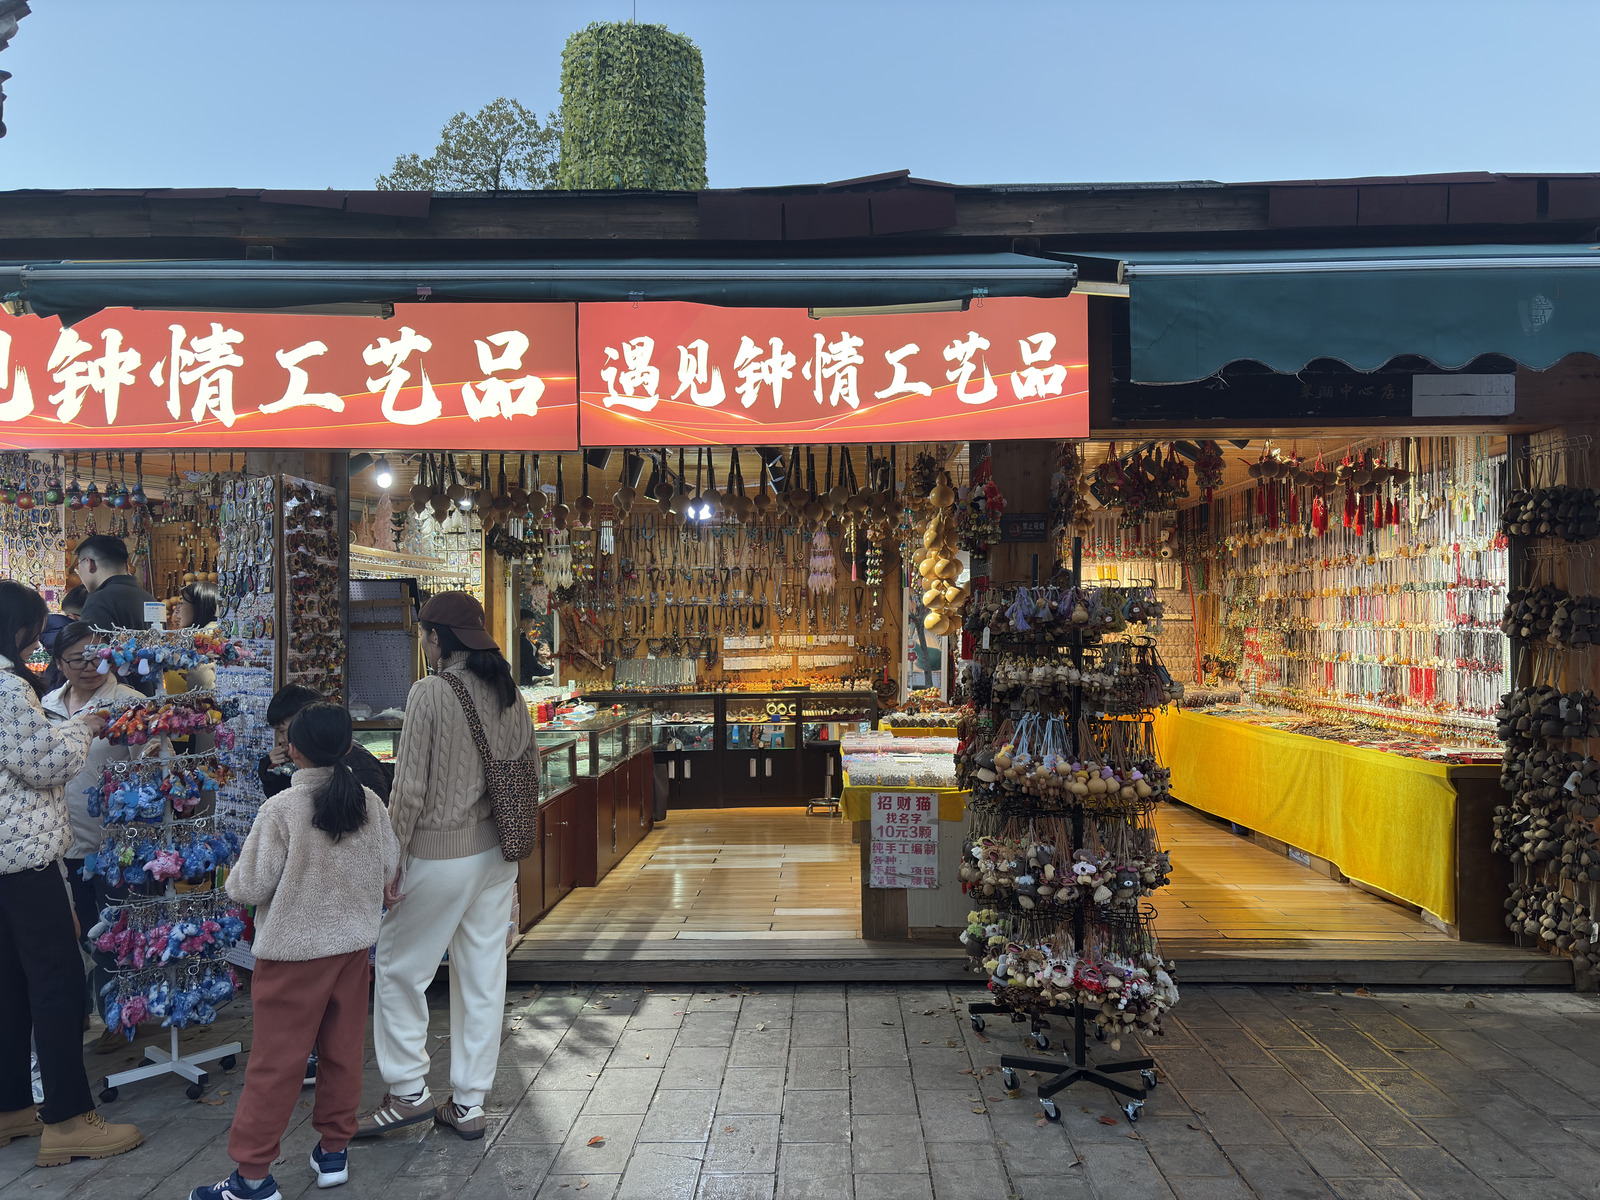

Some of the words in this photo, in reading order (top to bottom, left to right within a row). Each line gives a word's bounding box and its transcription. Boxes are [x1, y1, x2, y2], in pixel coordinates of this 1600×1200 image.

[600, 331, 1067, 411] 遇见钟情工艺品
[877, 796, 931, 811] 招财猫
[886, 813, 922, 824] 找名字
[876, 825, 932, 839] 10元3颗
[872, 843, 936, 855] 纯手工编制
